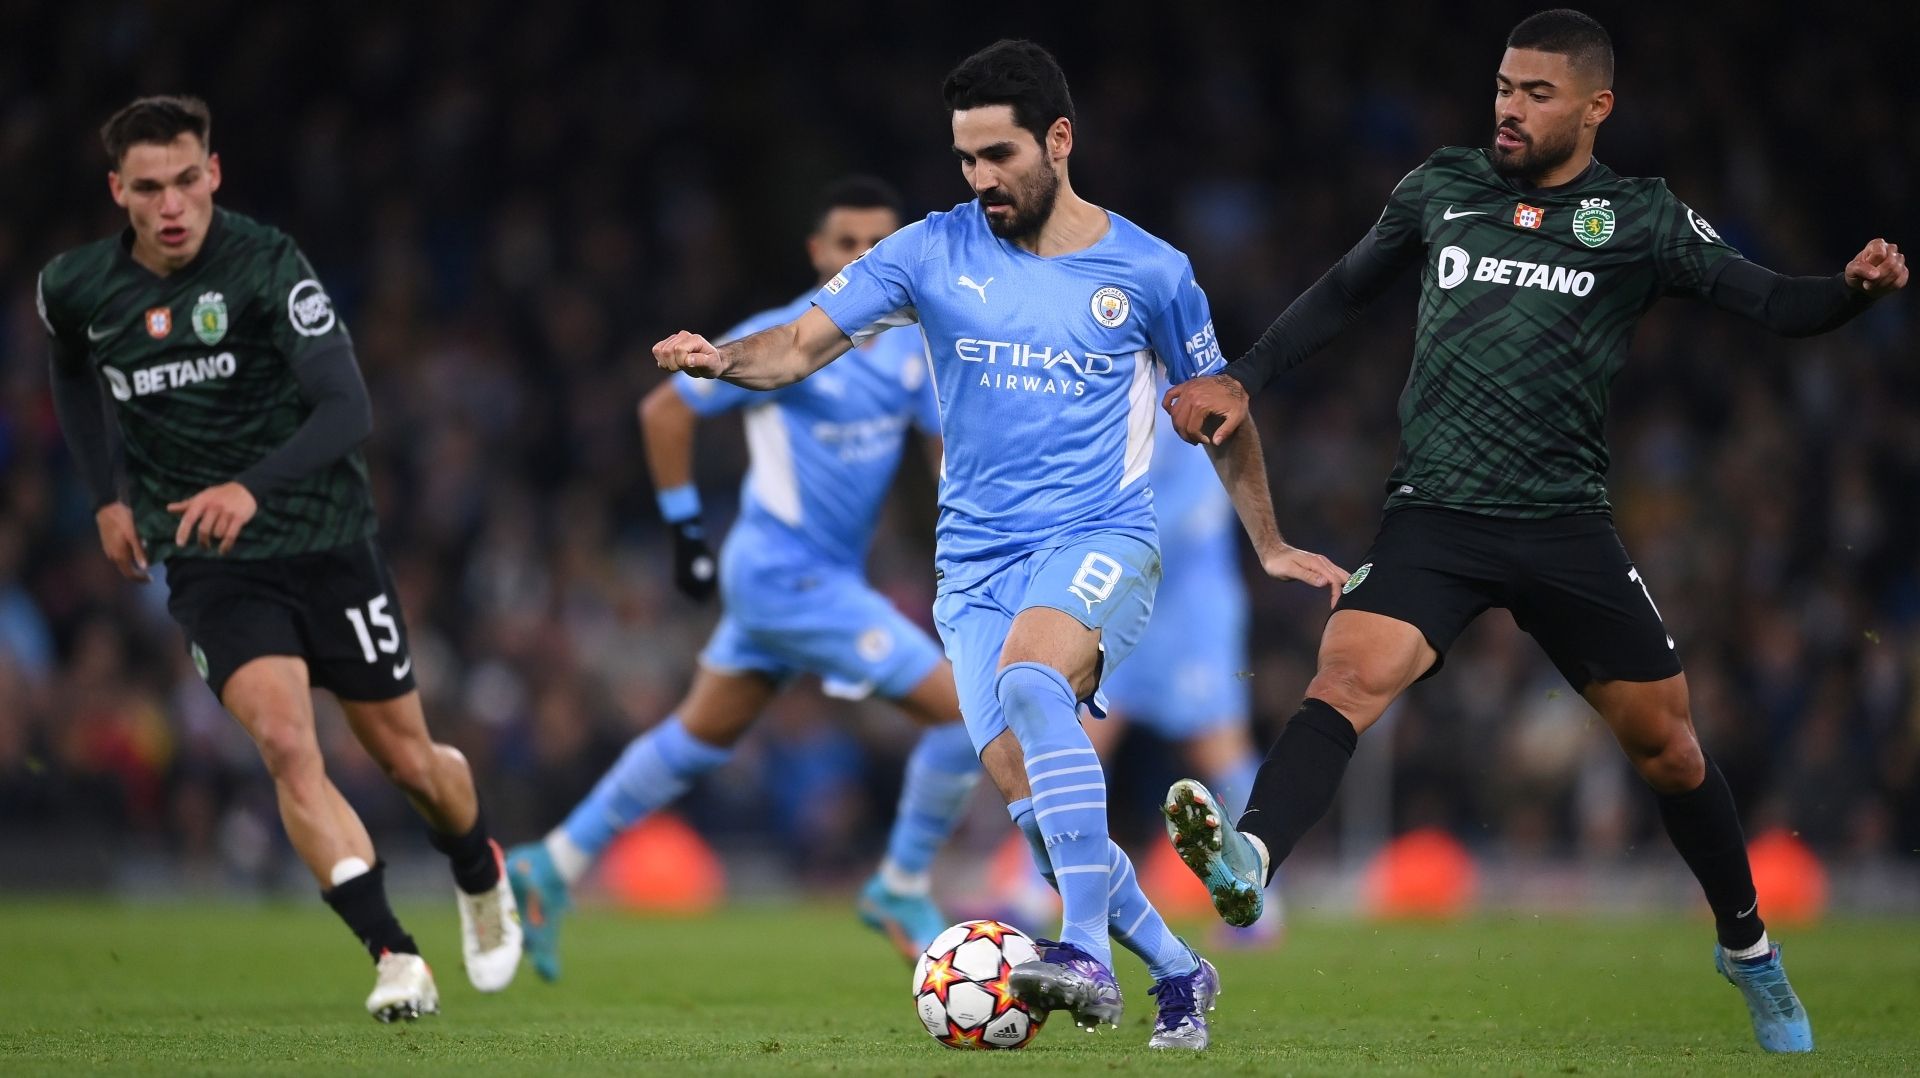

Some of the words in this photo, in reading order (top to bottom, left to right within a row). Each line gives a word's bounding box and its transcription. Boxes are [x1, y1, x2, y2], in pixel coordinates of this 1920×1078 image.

[1578, 209, 1611, 220] SPORTING
[1580, 198, 1611, 209] SCP
[1472, 256, 1595, 297] BETANO
[132, 352, 236, 396] BETANO
[955, 338, 1113, 375] ETIHAD
[979, 372, 1085, 396] AIRWAYS
[1072, 552, 1122, 601] 8
[345, 593, 399, 663] 15
